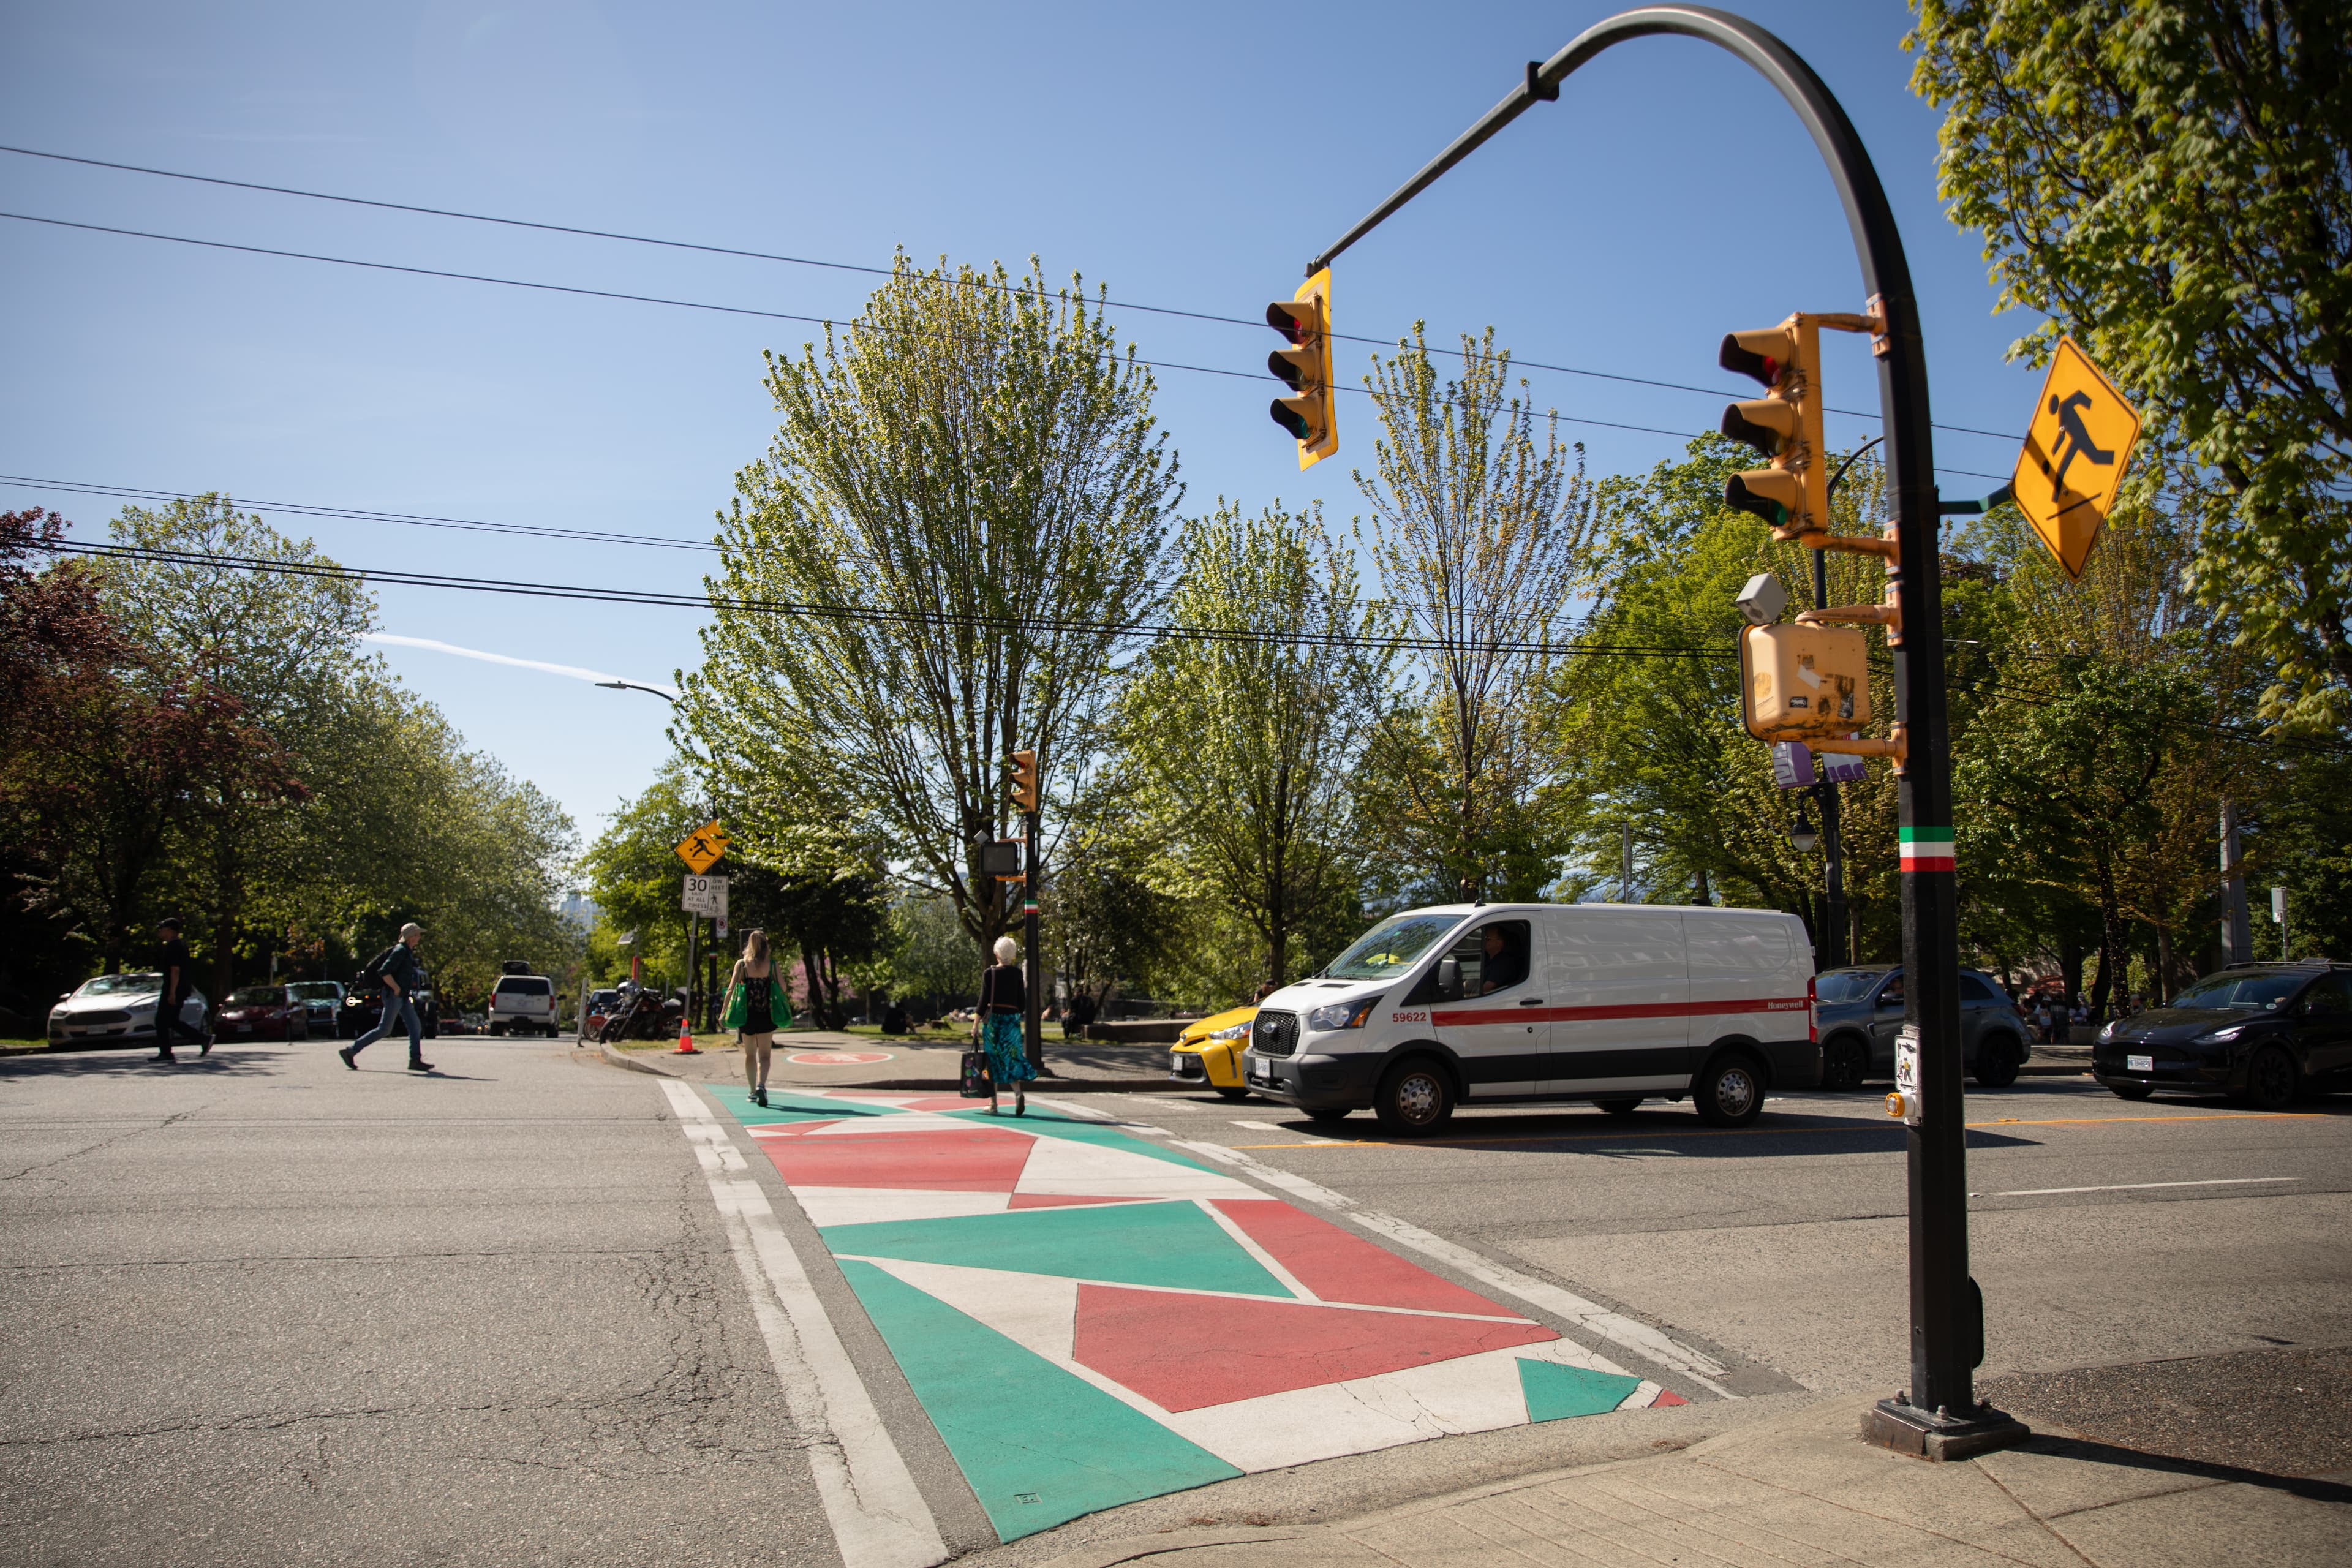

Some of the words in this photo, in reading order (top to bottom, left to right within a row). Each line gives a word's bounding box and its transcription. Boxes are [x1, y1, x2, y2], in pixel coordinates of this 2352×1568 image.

[688, 878, 707, 892] 30
[1768, 1000, 1803, 1010] Honeywell
[1392, 1012, 1427, 1022] 59622
